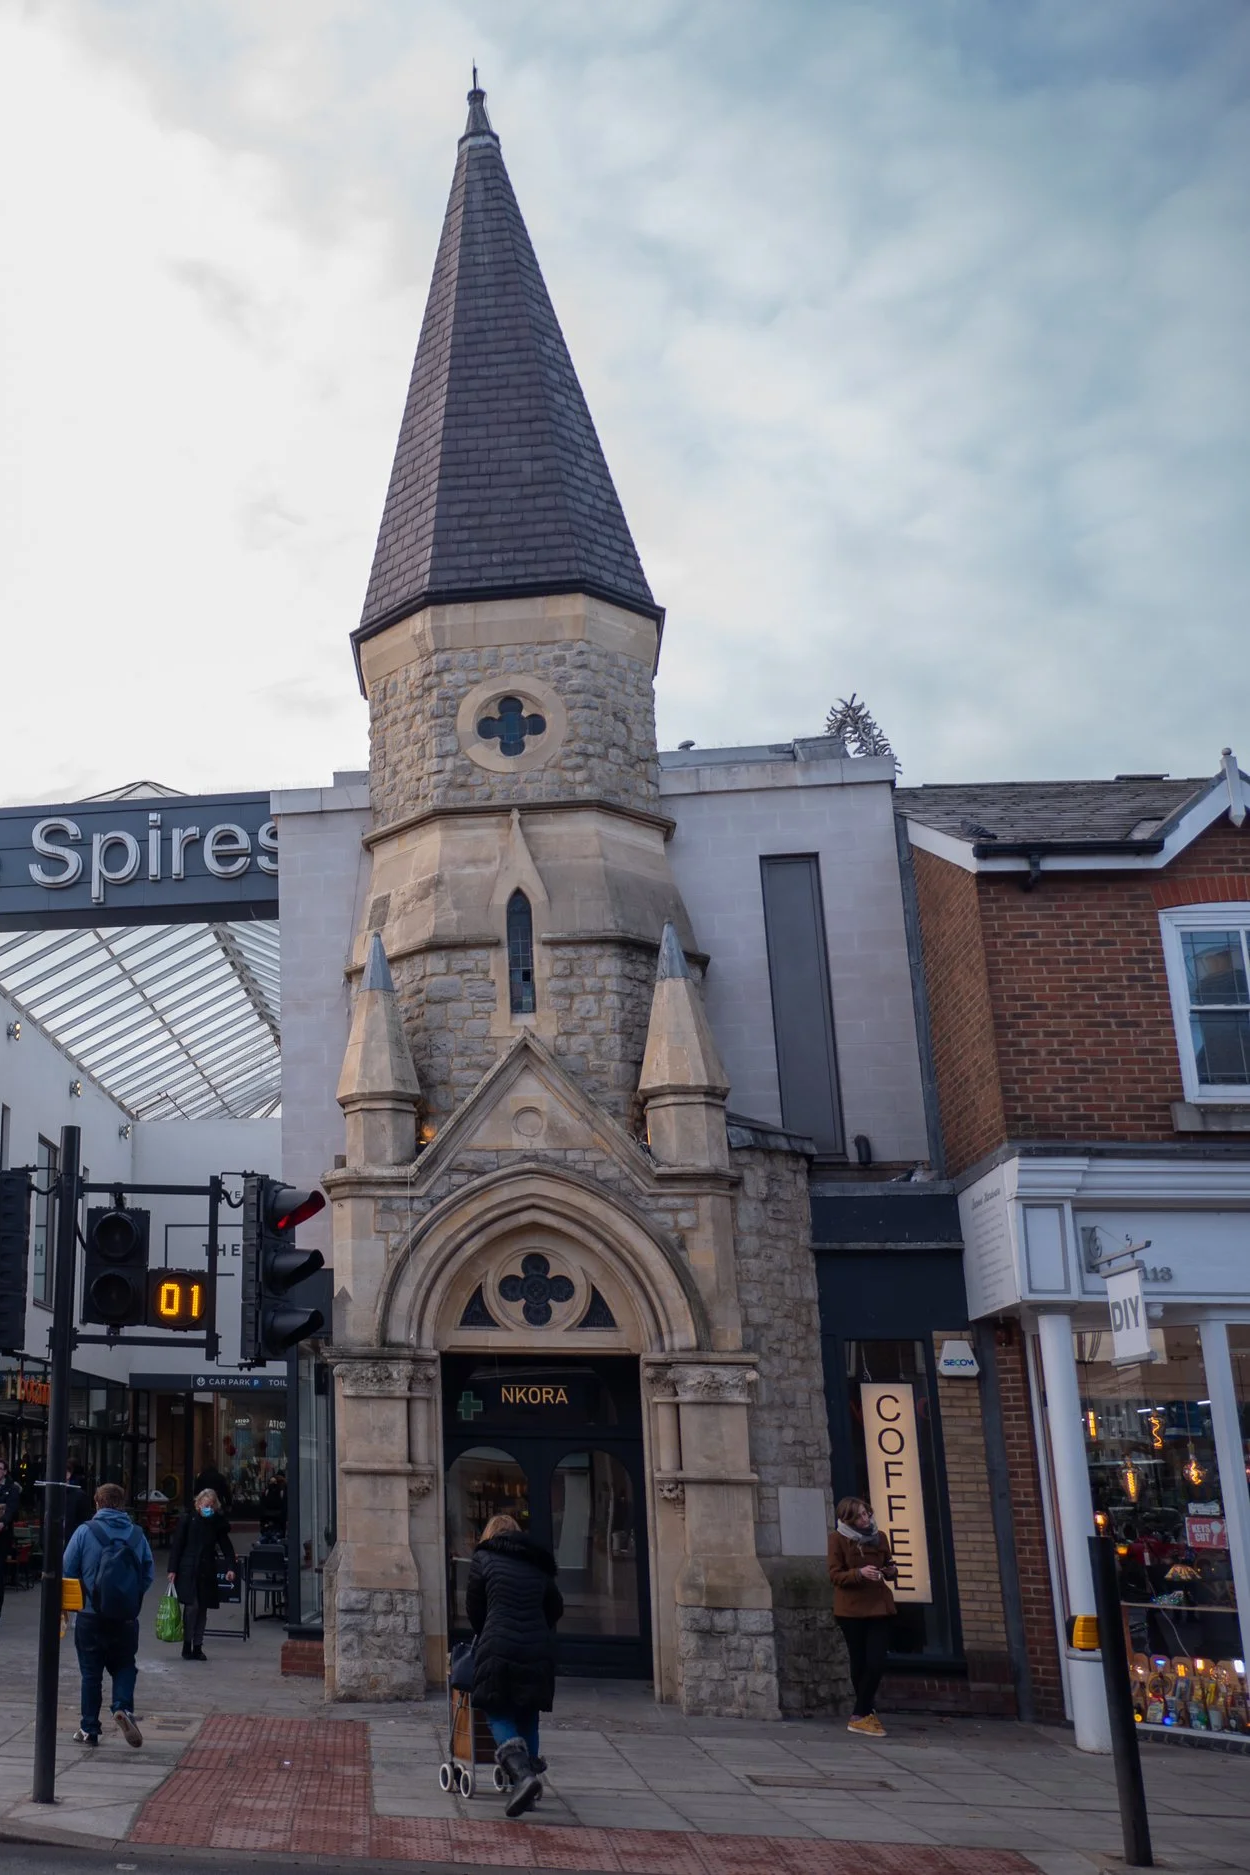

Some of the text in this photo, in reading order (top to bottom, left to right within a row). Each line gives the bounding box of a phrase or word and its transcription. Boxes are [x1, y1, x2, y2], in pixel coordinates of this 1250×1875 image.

[160, 1283, 199, 1317] 01
[1110, 1295, 1139, 1333] DIY
[209, 1378, 226, 1386] CAR
[228, 1378, 250, 1386] PARK
[269, 1379, 287, 1387] TOIL
[501, 1386, 569, 1404] NKORA
[876, 1394, 916, 1591] COFFEE
[1195, 1533, 1210, 1542] CUT
